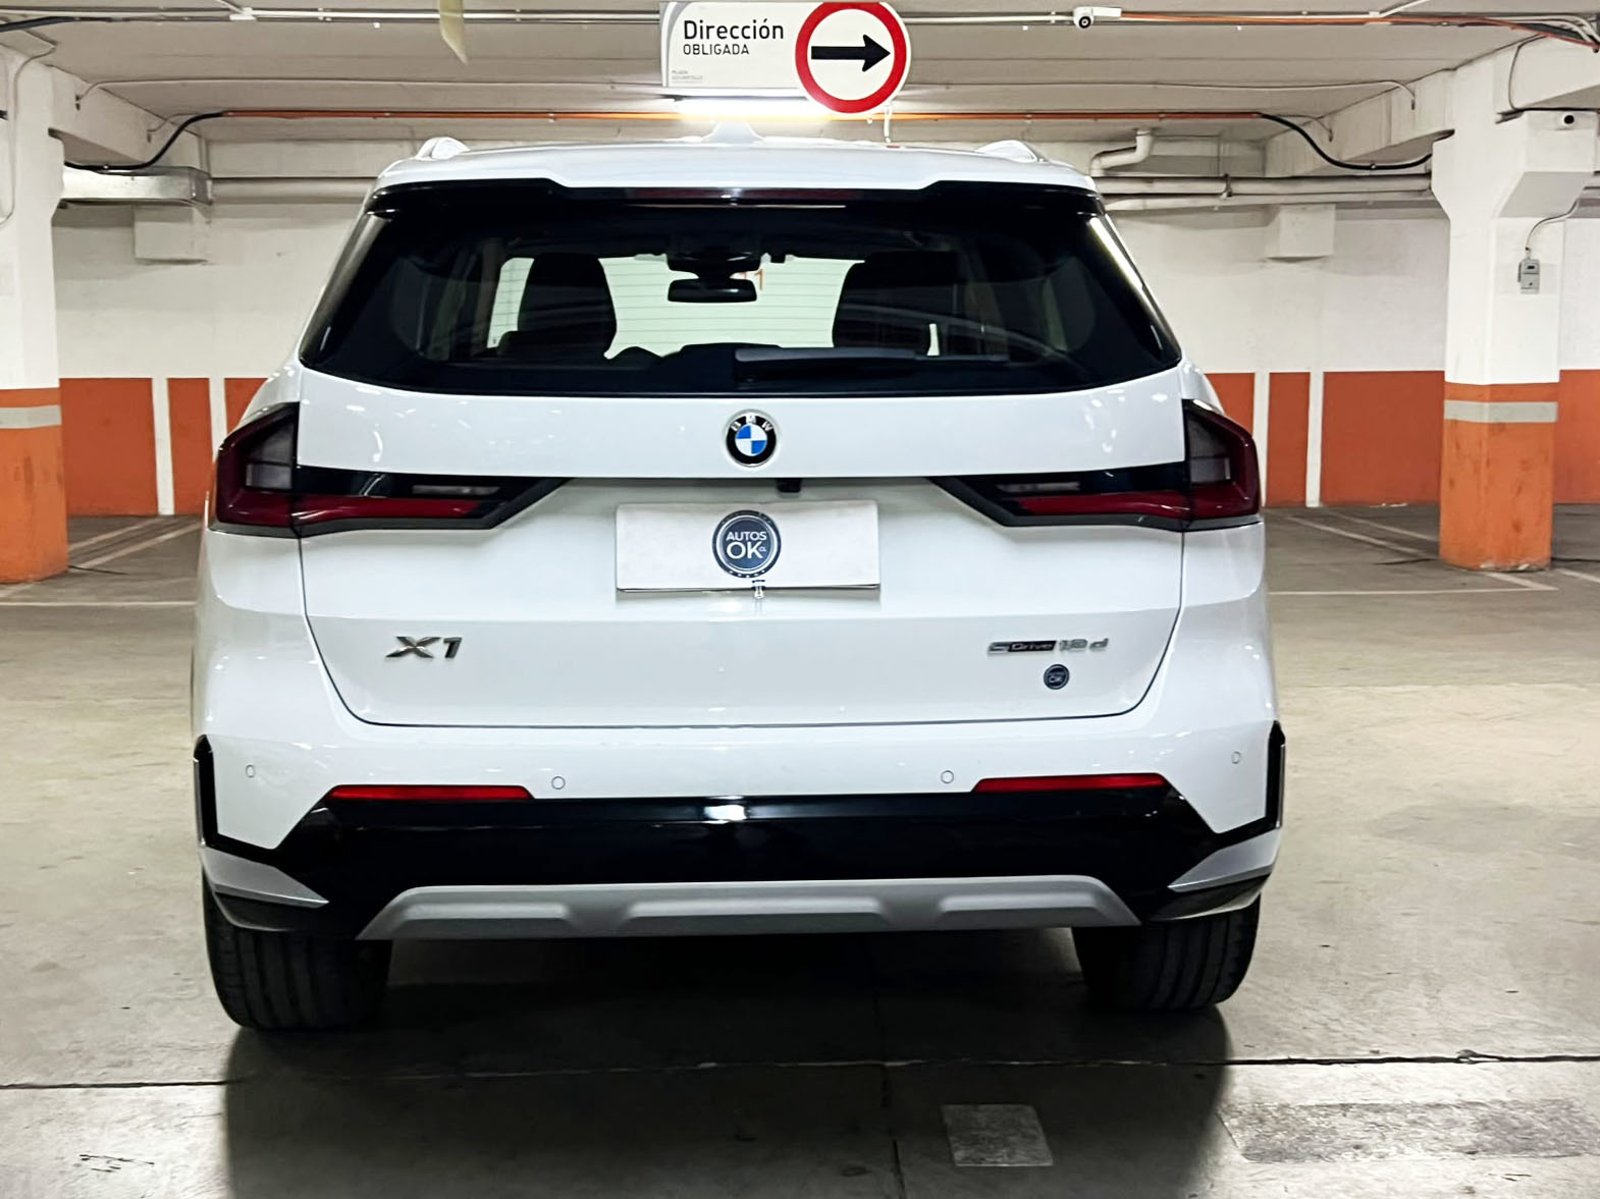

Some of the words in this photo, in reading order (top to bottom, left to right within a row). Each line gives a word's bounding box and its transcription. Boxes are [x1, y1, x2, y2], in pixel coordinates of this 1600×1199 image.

[683, 18, 784, 40] Dirección
[683, 43, 750, 56] OBLIGADA
[730, 413, 774, 432] BMW
[726, 531, 768, 541] AUTOS
[726, 541, 763, 559] OK
[385, 636, 463, 659] X1
